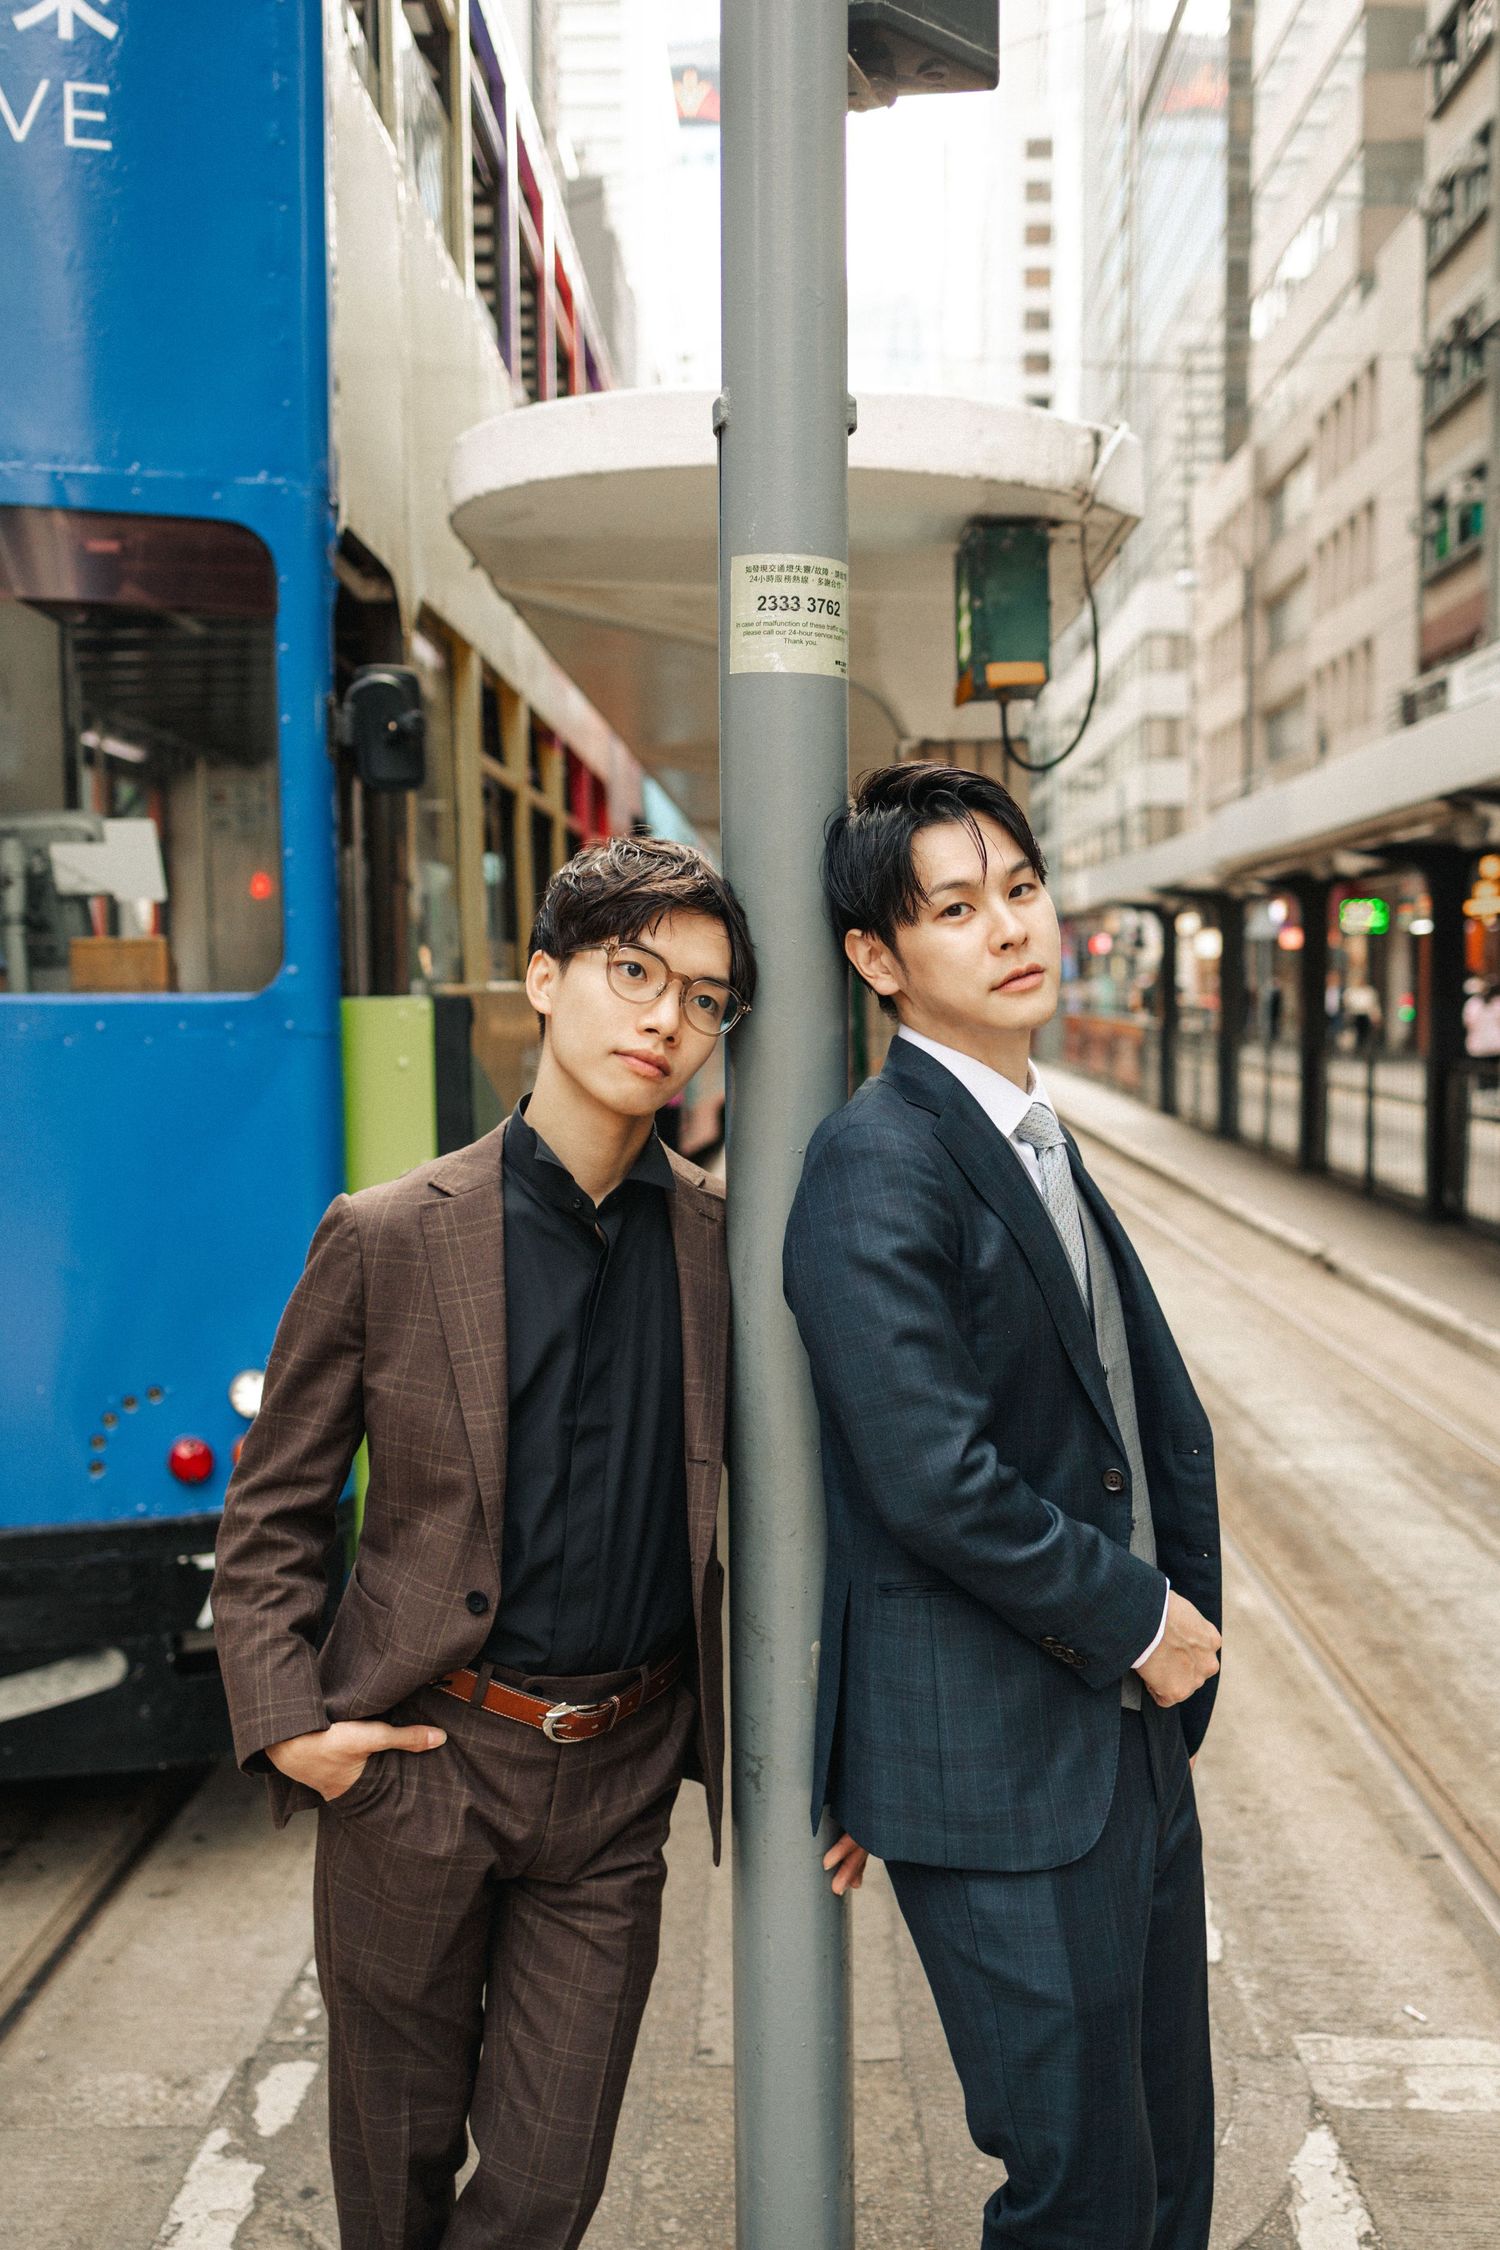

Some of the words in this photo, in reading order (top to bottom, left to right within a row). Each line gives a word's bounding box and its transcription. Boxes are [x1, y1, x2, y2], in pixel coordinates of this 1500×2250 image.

[757, 595, 801, 612] 2333
[807, 597, 841, 617] 3762
[809, 622, 826, 630] these
[743, 629, 762, 637] please
[788, 629, 814, 637] 24-hour
[783, 637, 804, 645] Thank
